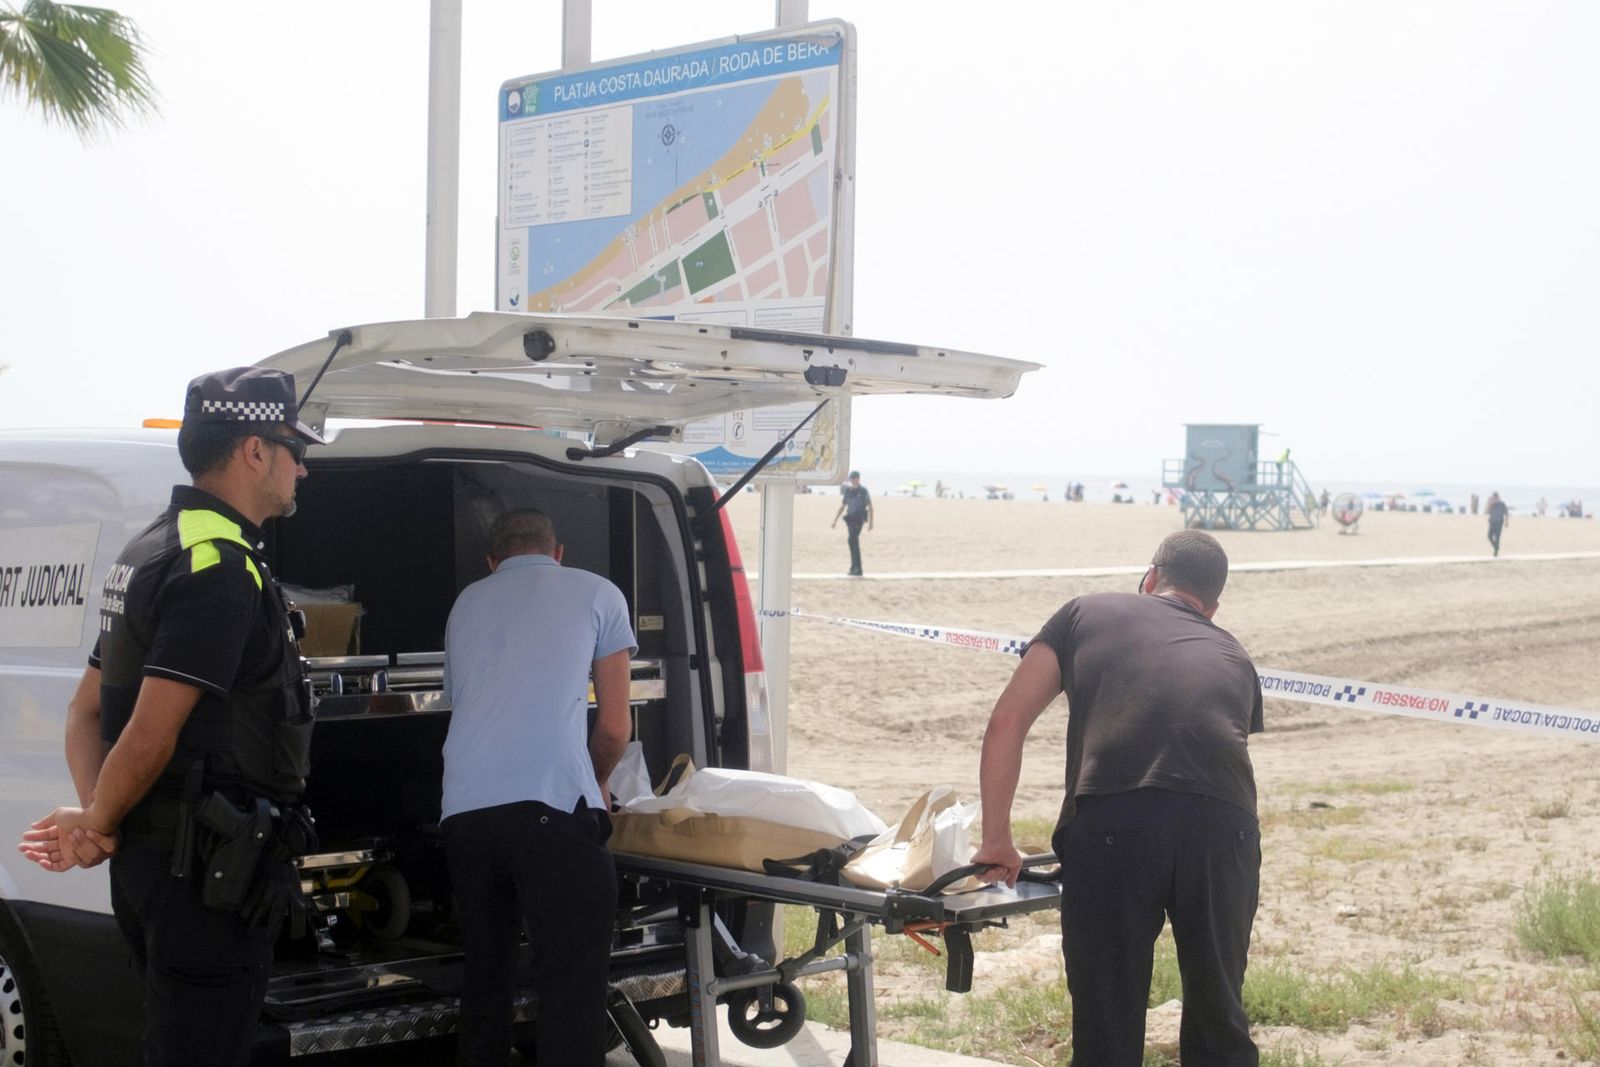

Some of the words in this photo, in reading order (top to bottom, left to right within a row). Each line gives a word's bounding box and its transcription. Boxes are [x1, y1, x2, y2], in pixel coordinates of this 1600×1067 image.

[554, 81, 597, 103] PLATJA
[599, 72, 642, 95] COSTA
[643, 60, 710, 87] DAURADA
[719, 50, 760, 74] RODA
[763, 45, 784, 65] DE
[21, 563, 84, 607] JUDICIAL
[945, 632, 983, 648] PASSEU
[984, 637, 1000, 650] NO
[1257, 676, 1281, 690] LOC
[1284, 680, 1331, 697] POLICIA
[1372, 690, 1426, 710] PASSEU
[1428, 698, 1450, 713] NO
[1492, 707, 1541, 725] LOCAL
[1544, 713, 1600, 733] POLICIA
